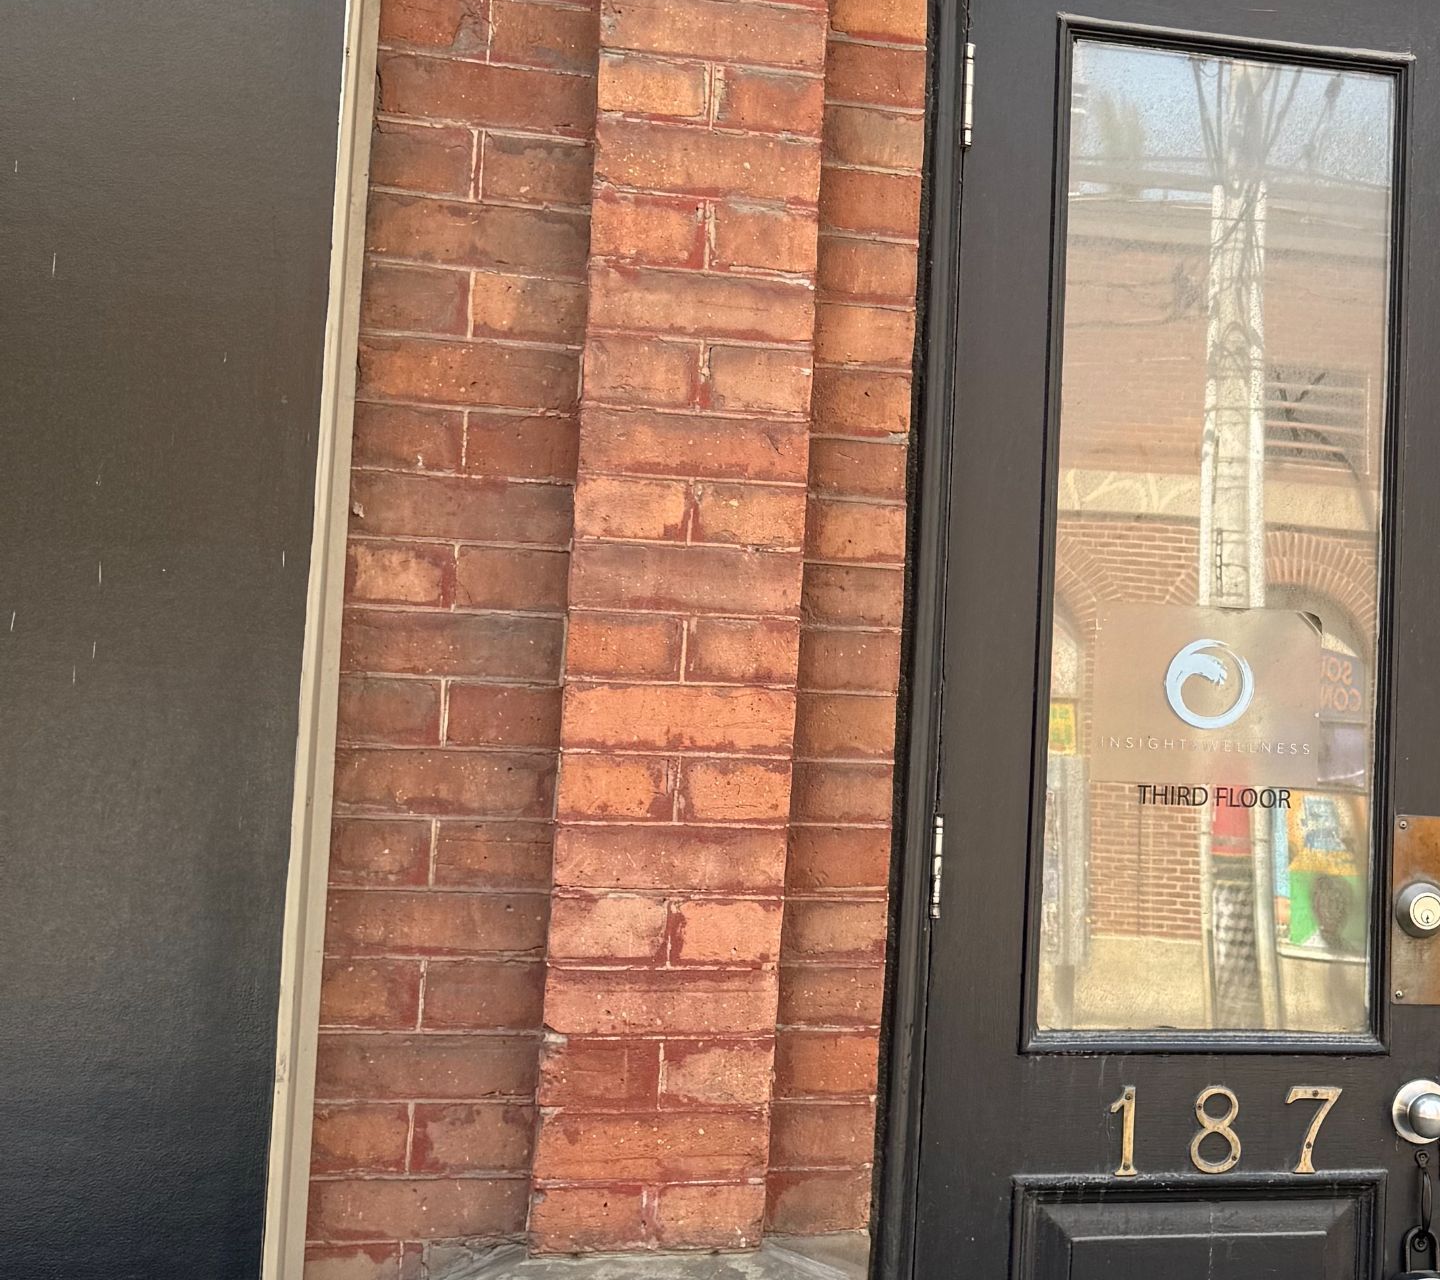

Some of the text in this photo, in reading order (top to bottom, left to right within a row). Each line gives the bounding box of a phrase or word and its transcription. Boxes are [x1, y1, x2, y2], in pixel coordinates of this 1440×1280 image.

[1100, 736, 1186, 750] INSIGHT
[1206, 739, 1311, 755] WELLNESS
[1137, 784, 1292, 809] THIRD FLOOR
[1110, 1084, 1344, 1177] 187
